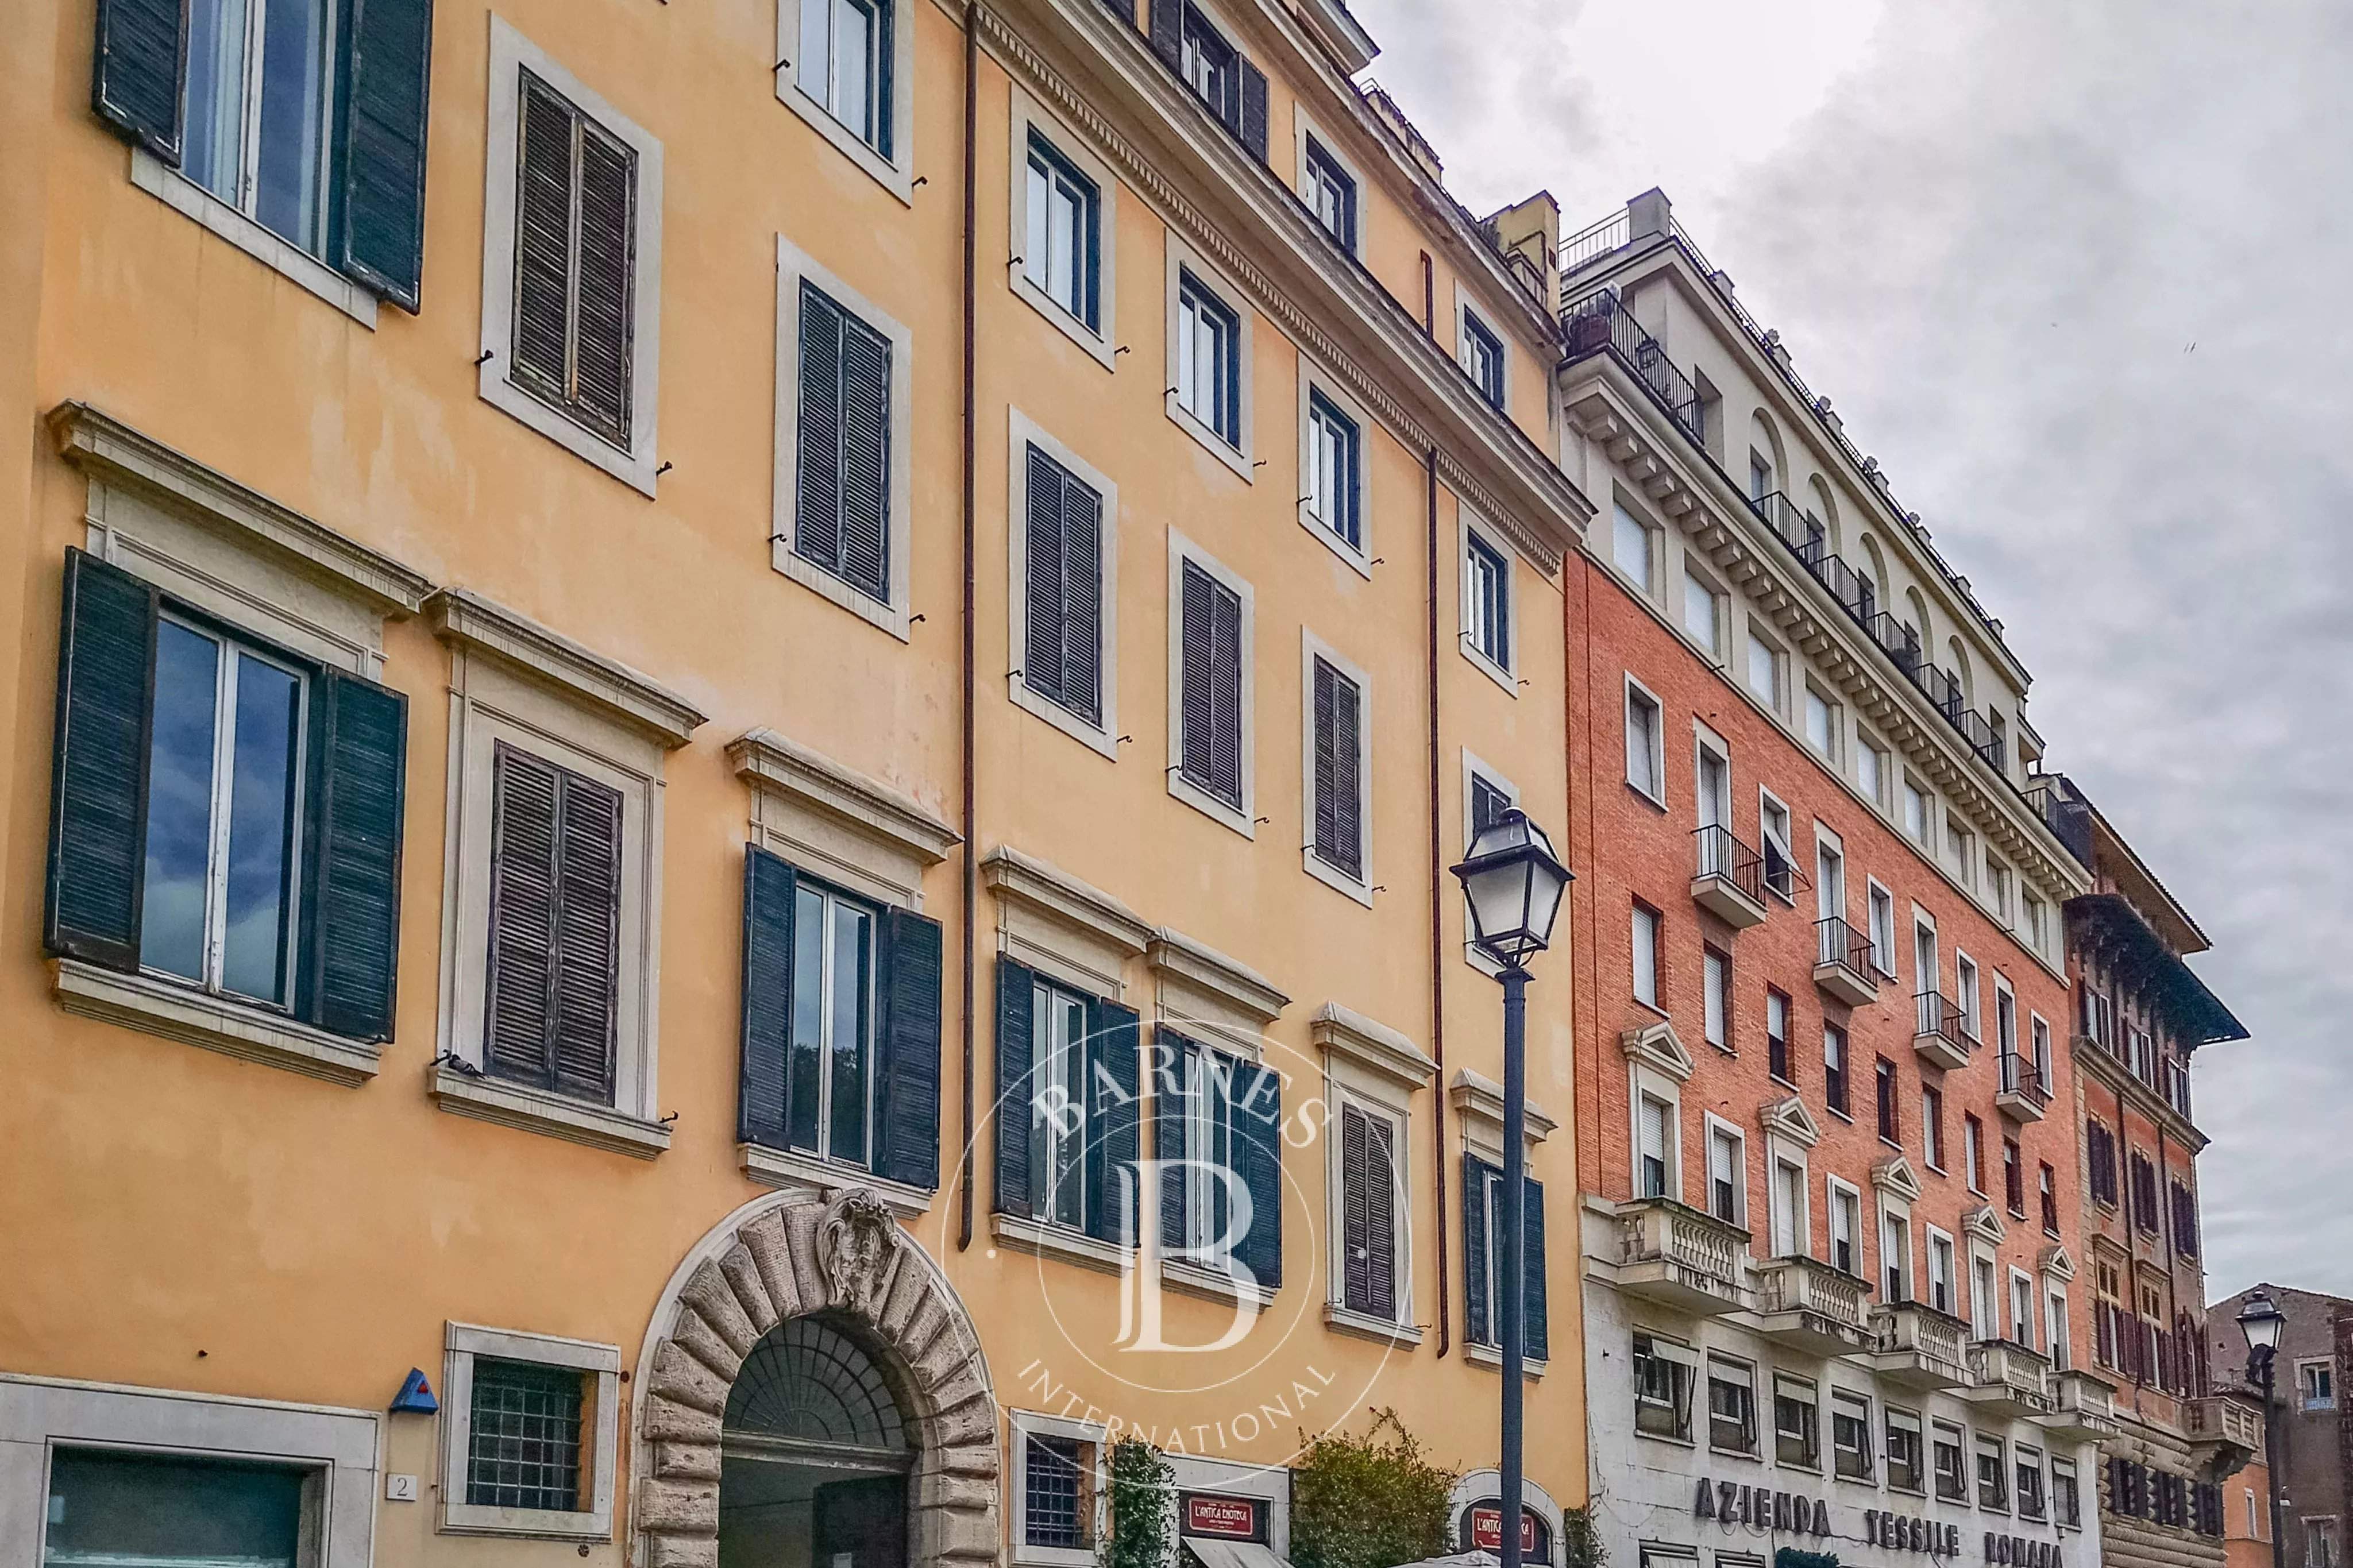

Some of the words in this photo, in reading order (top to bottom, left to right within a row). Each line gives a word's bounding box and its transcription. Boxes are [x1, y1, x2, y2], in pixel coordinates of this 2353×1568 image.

[397, 1477, 408, 1496] 2
[1195, 1505, 1221, 1519] L'ANTICA
[1222, 1508, 1247, 1521] ENOTECA
[1695, 1477, 1831, 1536] AZIENDA
[1864, 1509, 1959, 1557] TESSILE
[1984, 1531, 2063, 1568] ROMANA
